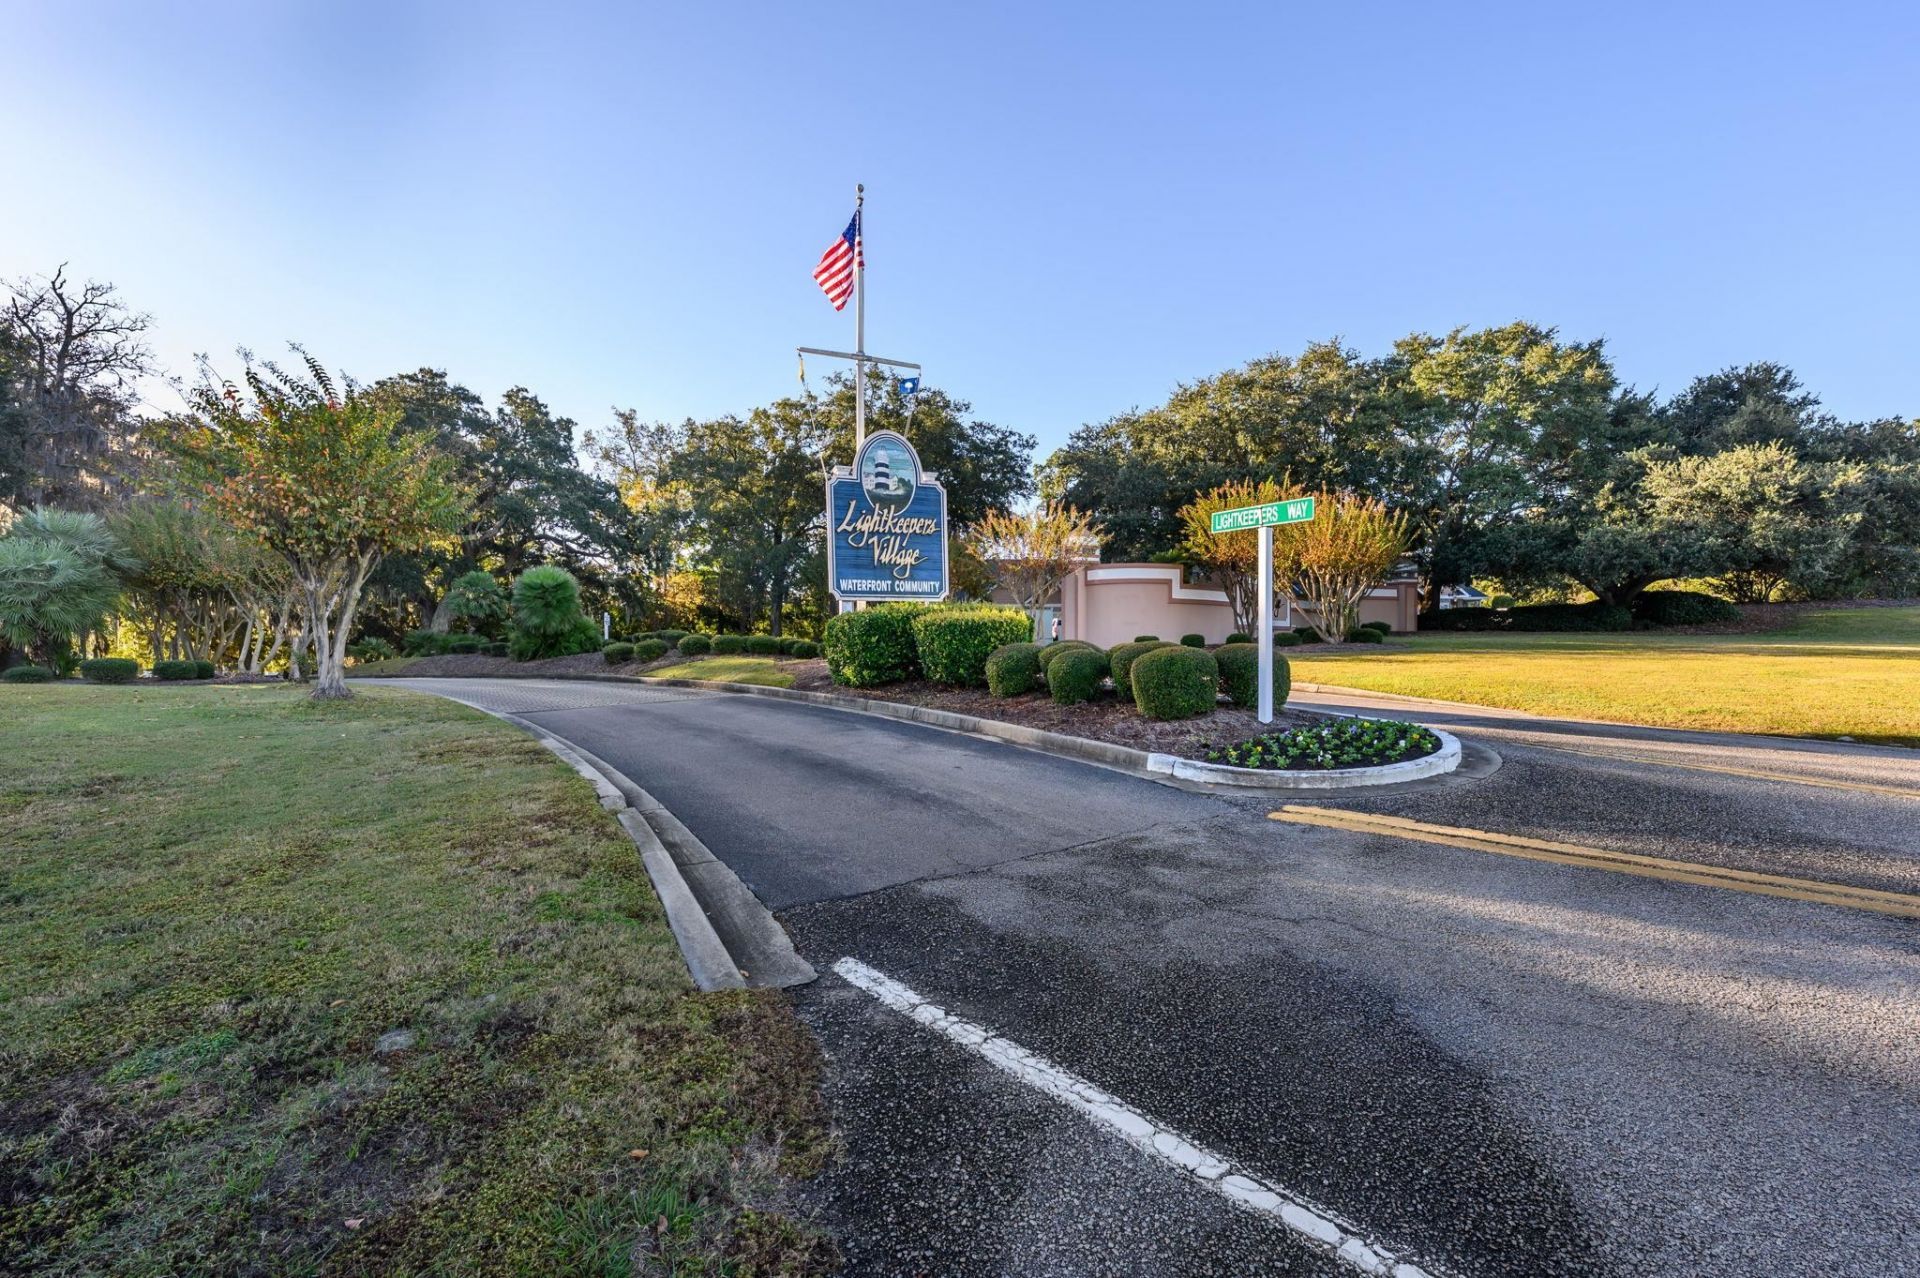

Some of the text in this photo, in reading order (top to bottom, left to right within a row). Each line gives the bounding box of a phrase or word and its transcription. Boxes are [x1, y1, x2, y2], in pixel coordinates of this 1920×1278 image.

[837, 500, 940, 547] Lightkeepers
[1215, 501, 1308, 529] LIGHTKEEPERS WAY
[868, 535, 928, 579] Village
[840, 579, 940, 593] WATERFRONT COMMUNITY
